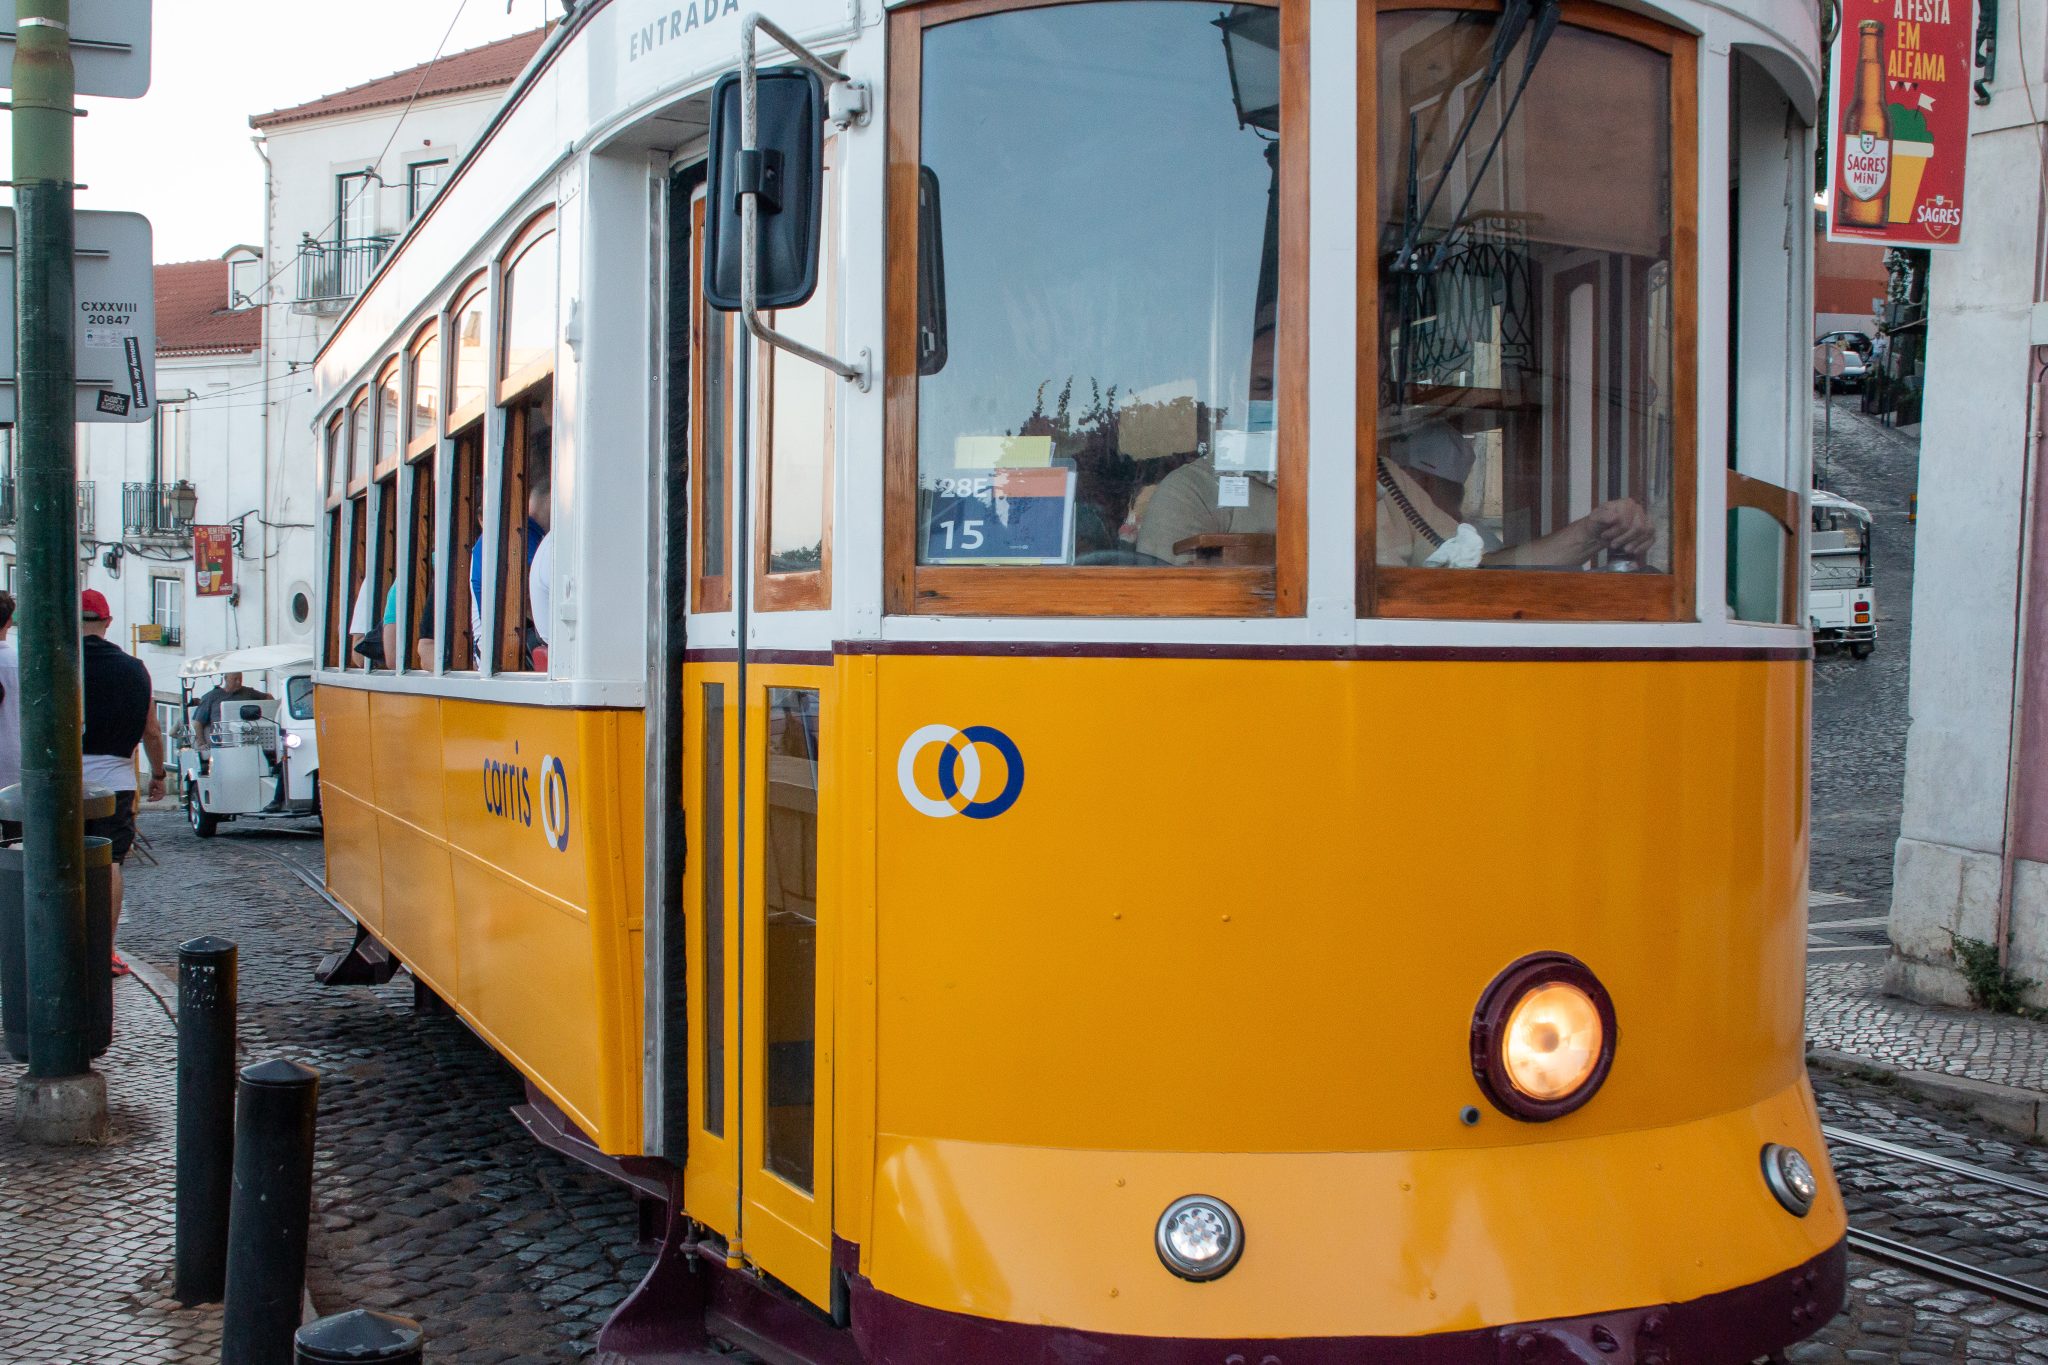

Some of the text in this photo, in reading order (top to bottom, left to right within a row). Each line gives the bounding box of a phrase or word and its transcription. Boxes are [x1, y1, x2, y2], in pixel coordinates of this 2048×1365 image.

[1894, 0, 1951, 24] A FESTA
[629, 0, 739, 62] ENTRADA
[1898, 21, 1920, 50] EM
[1888, 48, 1946, 82] ALFAMA
[1847, 153, 1886, 174] SAGRES
[1917, 205, 1960, 226] SAGRES
[81, 301, 137, 313] CXXXVIII
[88, 314, 130, 325] 20847
[940, 478, 988, 498] 28E
[940, 520, 984, 550] 15
[483, 739, 532, 828] carris
